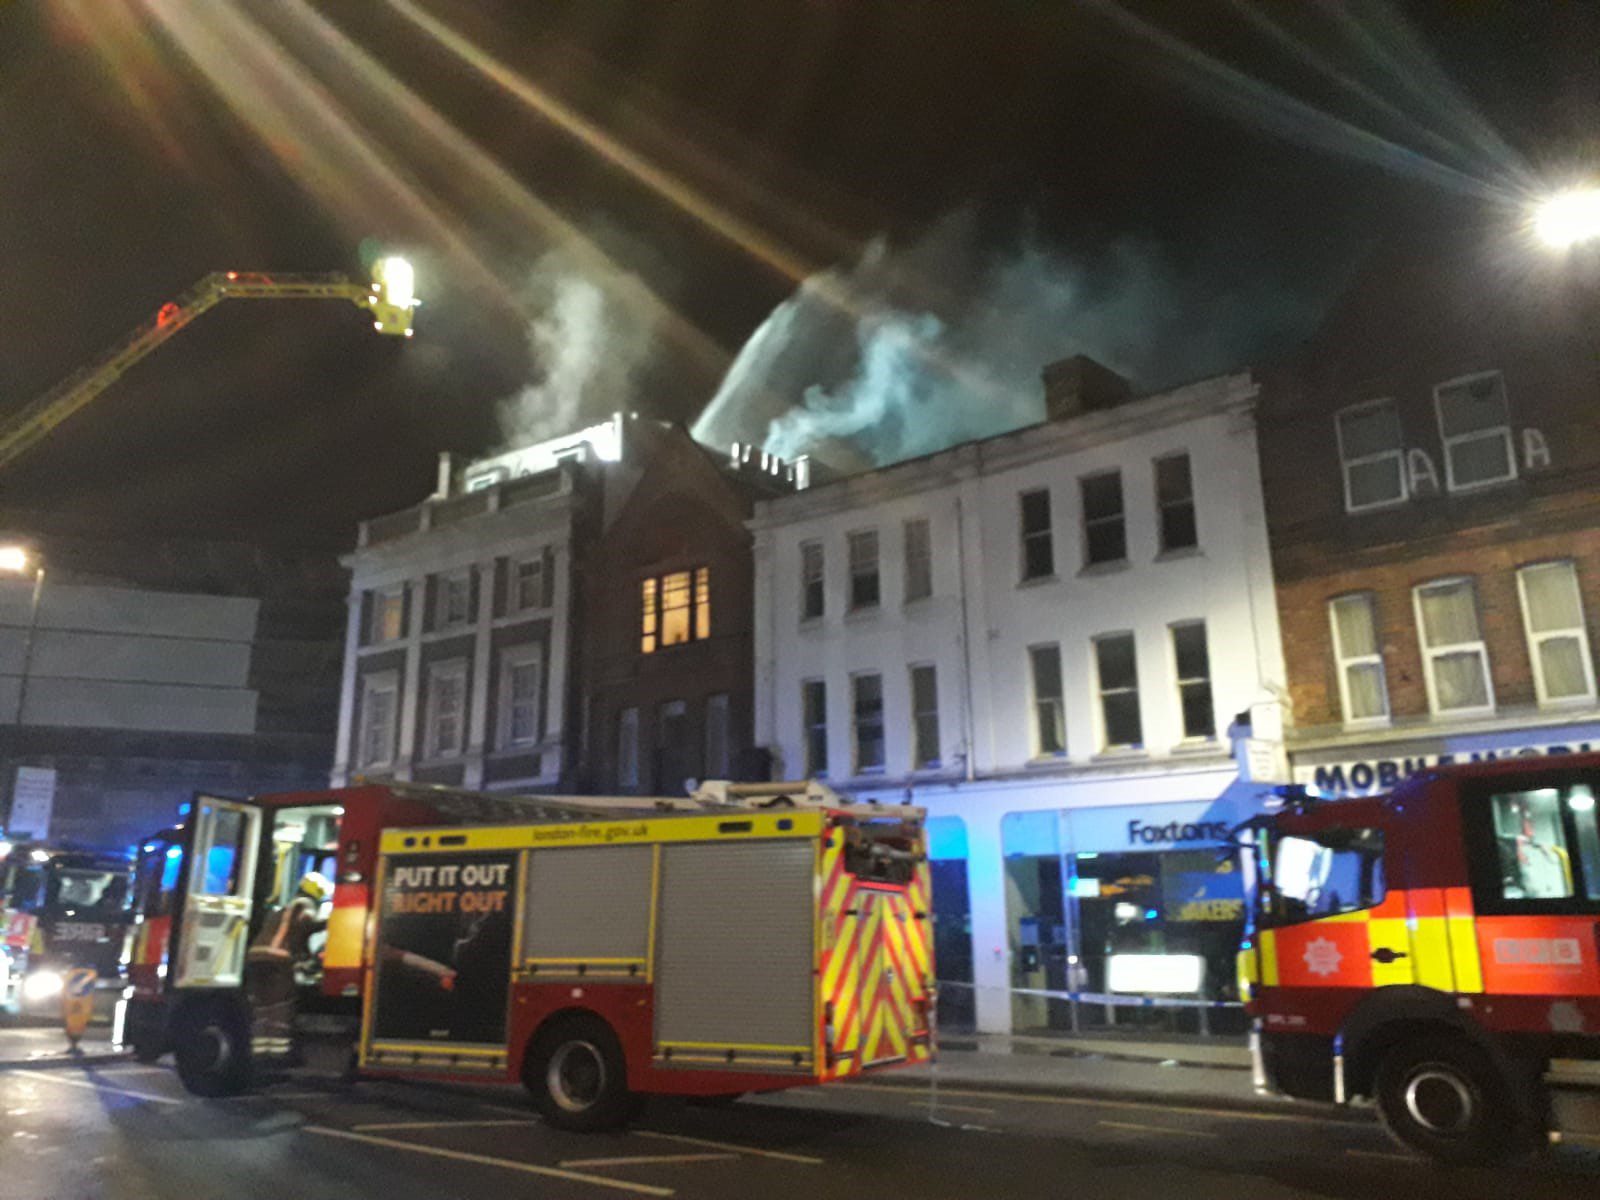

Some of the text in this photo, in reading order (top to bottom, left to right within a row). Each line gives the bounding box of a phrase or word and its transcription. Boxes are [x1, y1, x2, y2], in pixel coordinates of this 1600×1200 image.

[533, 824, 649, 842] london-fire.gov.uk
[1128, 819, 1228, 845] Foxtons
[394, 864, 510, 888] PUT IT OUT
[392, 890, 508, 913] RIGHT OUT
